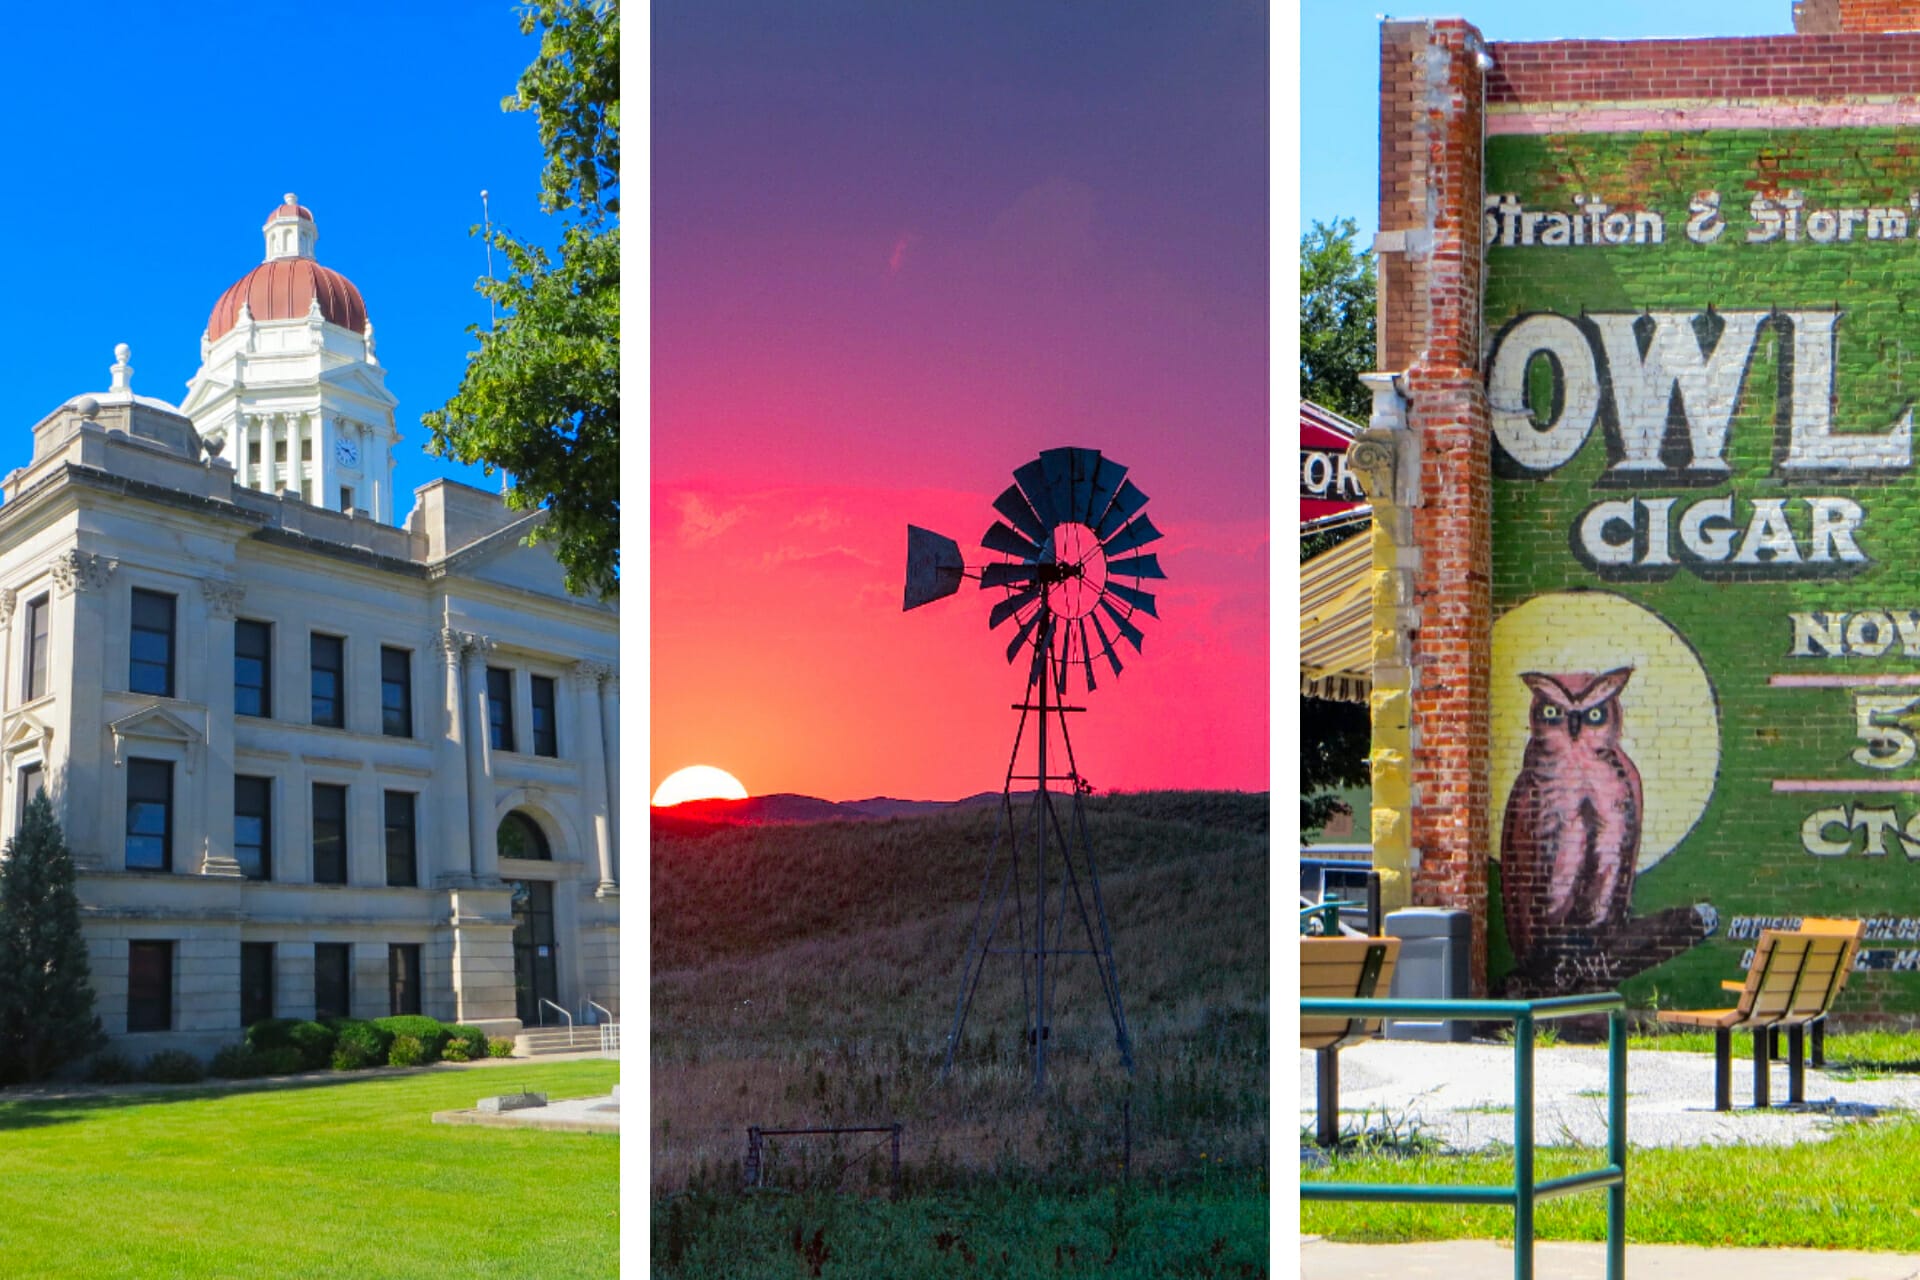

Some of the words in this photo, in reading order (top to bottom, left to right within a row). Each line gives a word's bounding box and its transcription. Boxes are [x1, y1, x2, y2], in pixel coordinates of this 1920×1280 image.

[1687, 191, 1725, 243] &
[1746, 189, 1920, 243] Storm'
[1486, 311, 1913, 472] OWL
[1578, 495, 1868, 568] CIGAR
